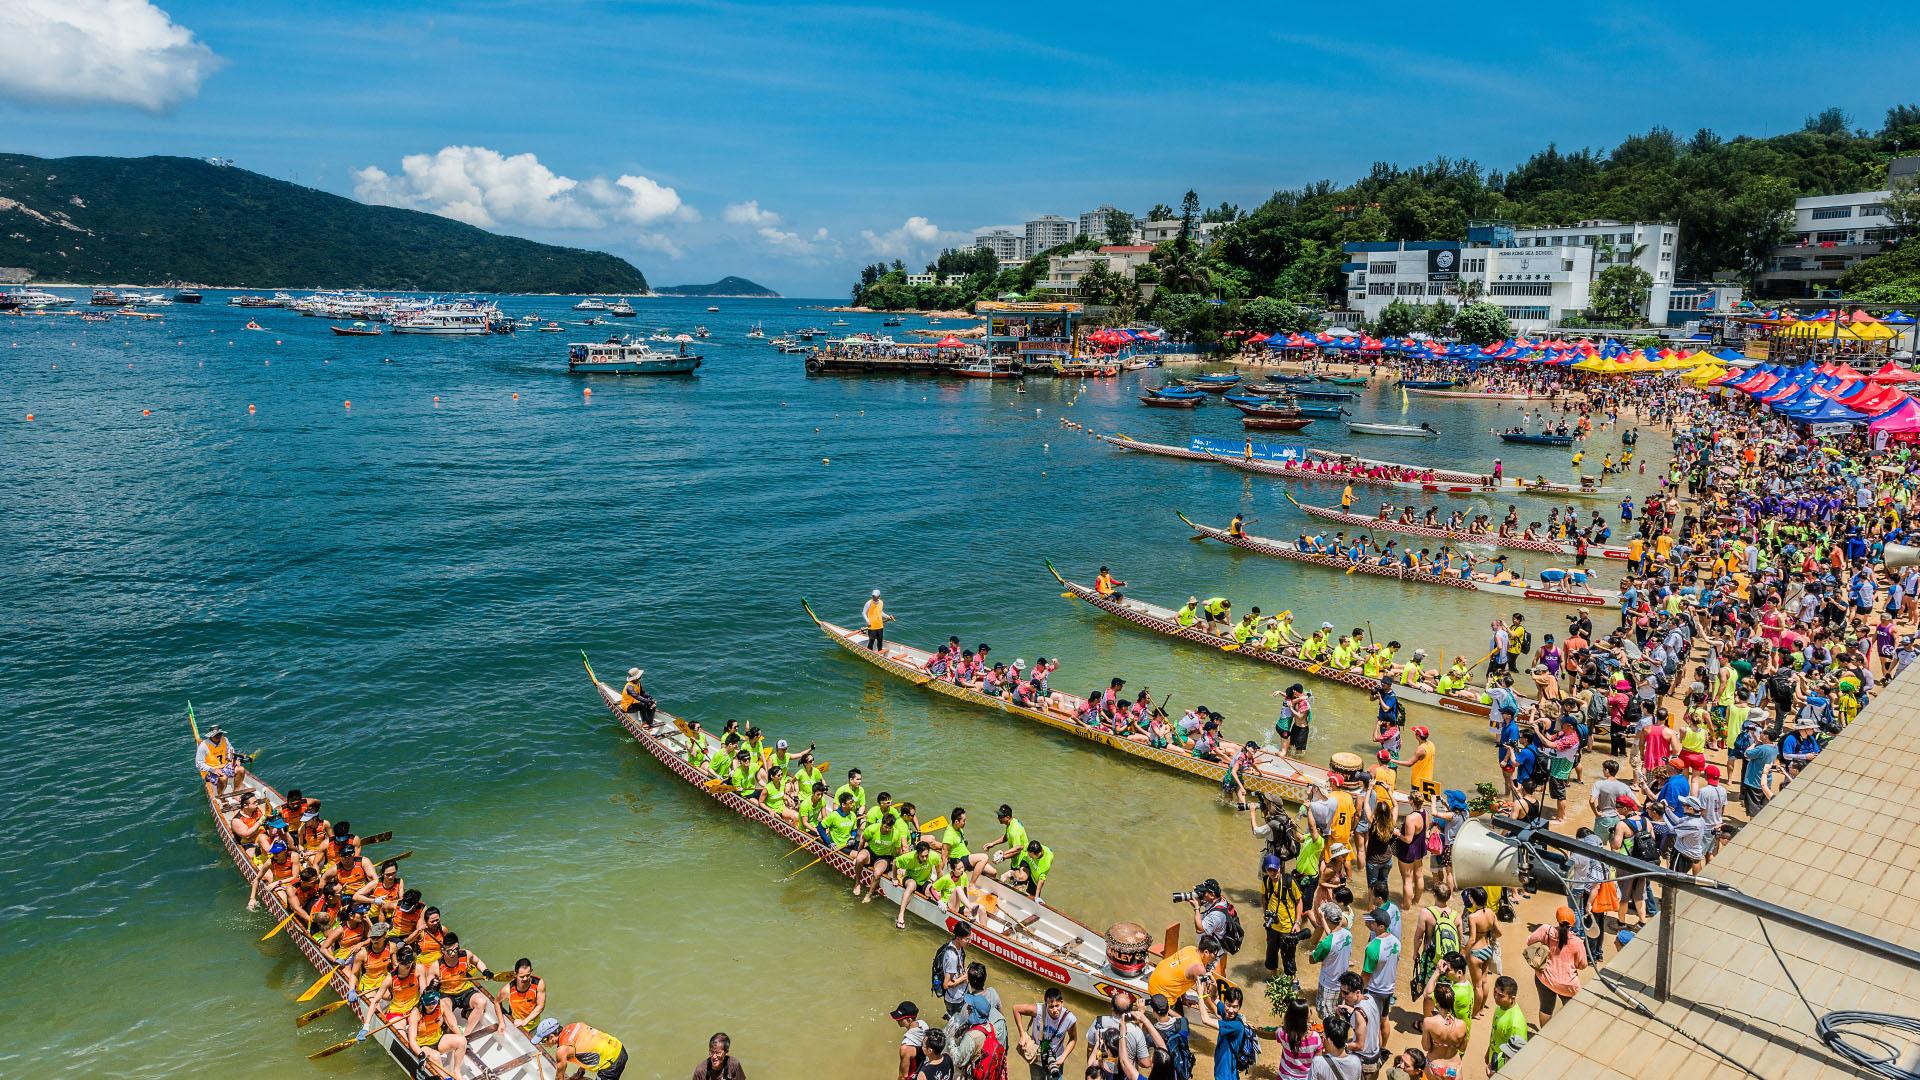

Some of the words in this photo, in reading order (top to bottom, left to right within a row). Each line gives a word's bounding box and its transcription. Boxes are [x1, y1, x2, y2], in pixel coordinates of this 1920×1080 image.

[1011, 327, 1024, 337] 38
[1076, 728, 1087, 737] Sun
[1090, 732, 1103, 741] Life
[216, 754, 223, 765] 7
[1423, 781, 1436, 802] 5
[1338, 812, 1346, 826] 5
